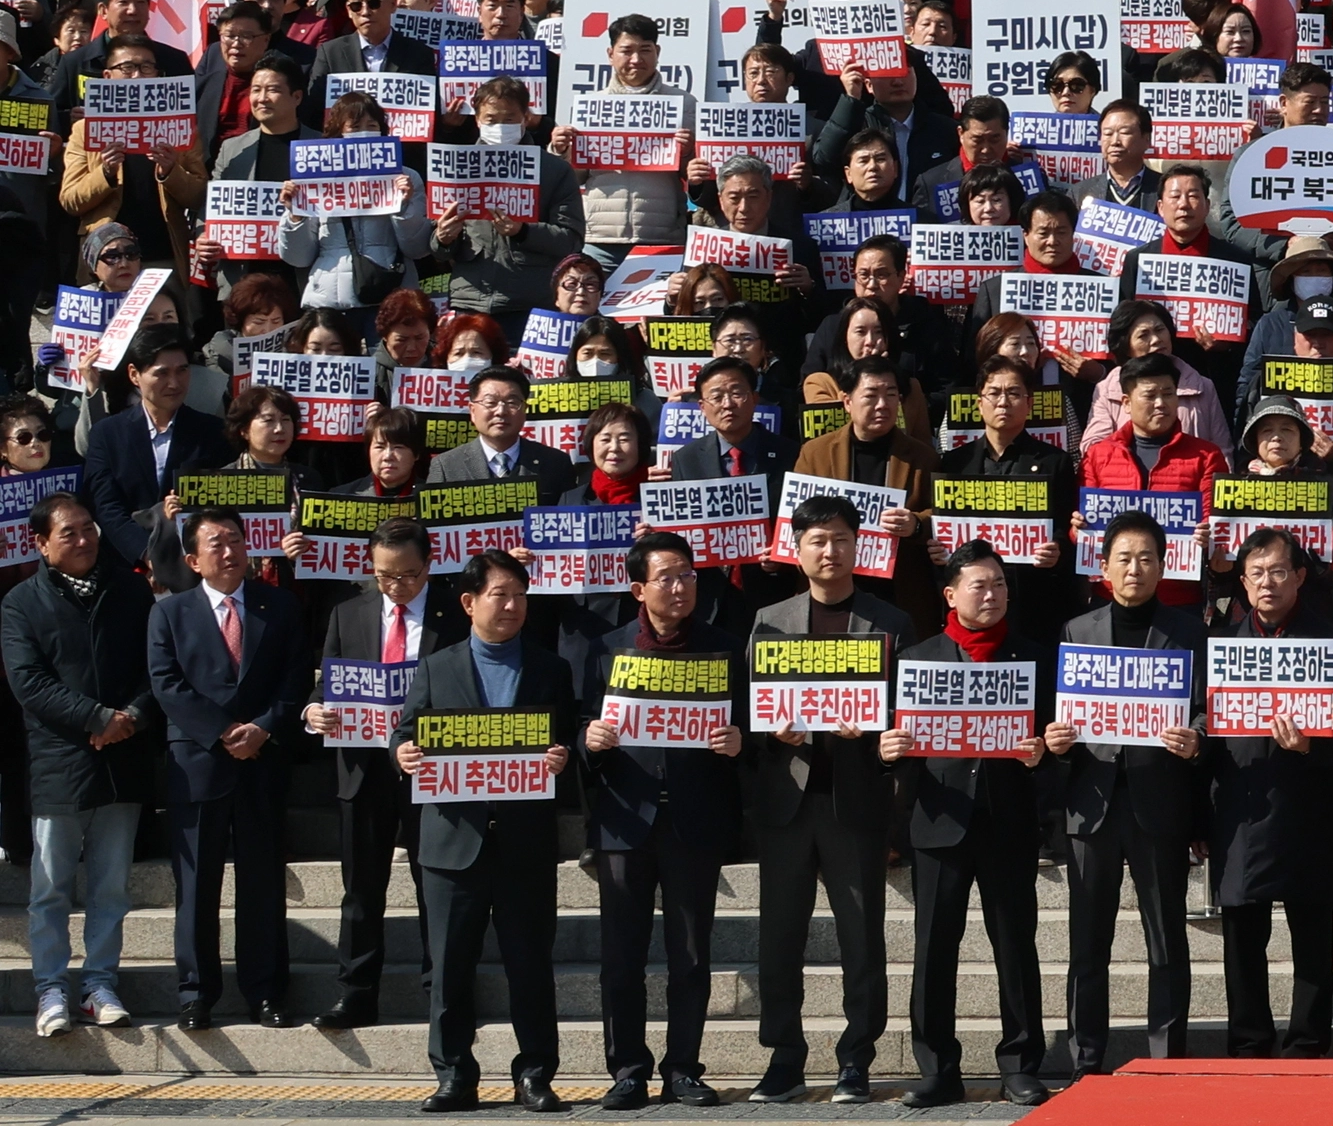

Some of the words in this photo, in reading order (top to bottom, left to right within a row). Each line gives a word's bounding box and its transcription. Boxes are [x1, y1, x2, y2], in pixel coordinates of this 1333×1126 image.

[986, 14, 1108, 52] 구미시(갑)
[86, 82, 145, 113] 국민분열
[149, 79, 195, 111] 조장하는
[576, 100, 624, 130] 국민분열
[629, 100, 678, 129] 조장하는
[295, 142, 344, 174] 광주전남
[484, 149, 536, 179] 조장하는
[1251, 177, 1295, 200] 대구
[754, 638, 881, 674] 대구경북행정통합특별법
[1062, 649, 1118, 687] 광주전남
[1122, 652, 1184, 690] 다퍼주고
[1212, 643, 1271, 685] 국민분열
[756, 684, 792, 725] 즉시
[902, 667, 961, 707] 국민분열
